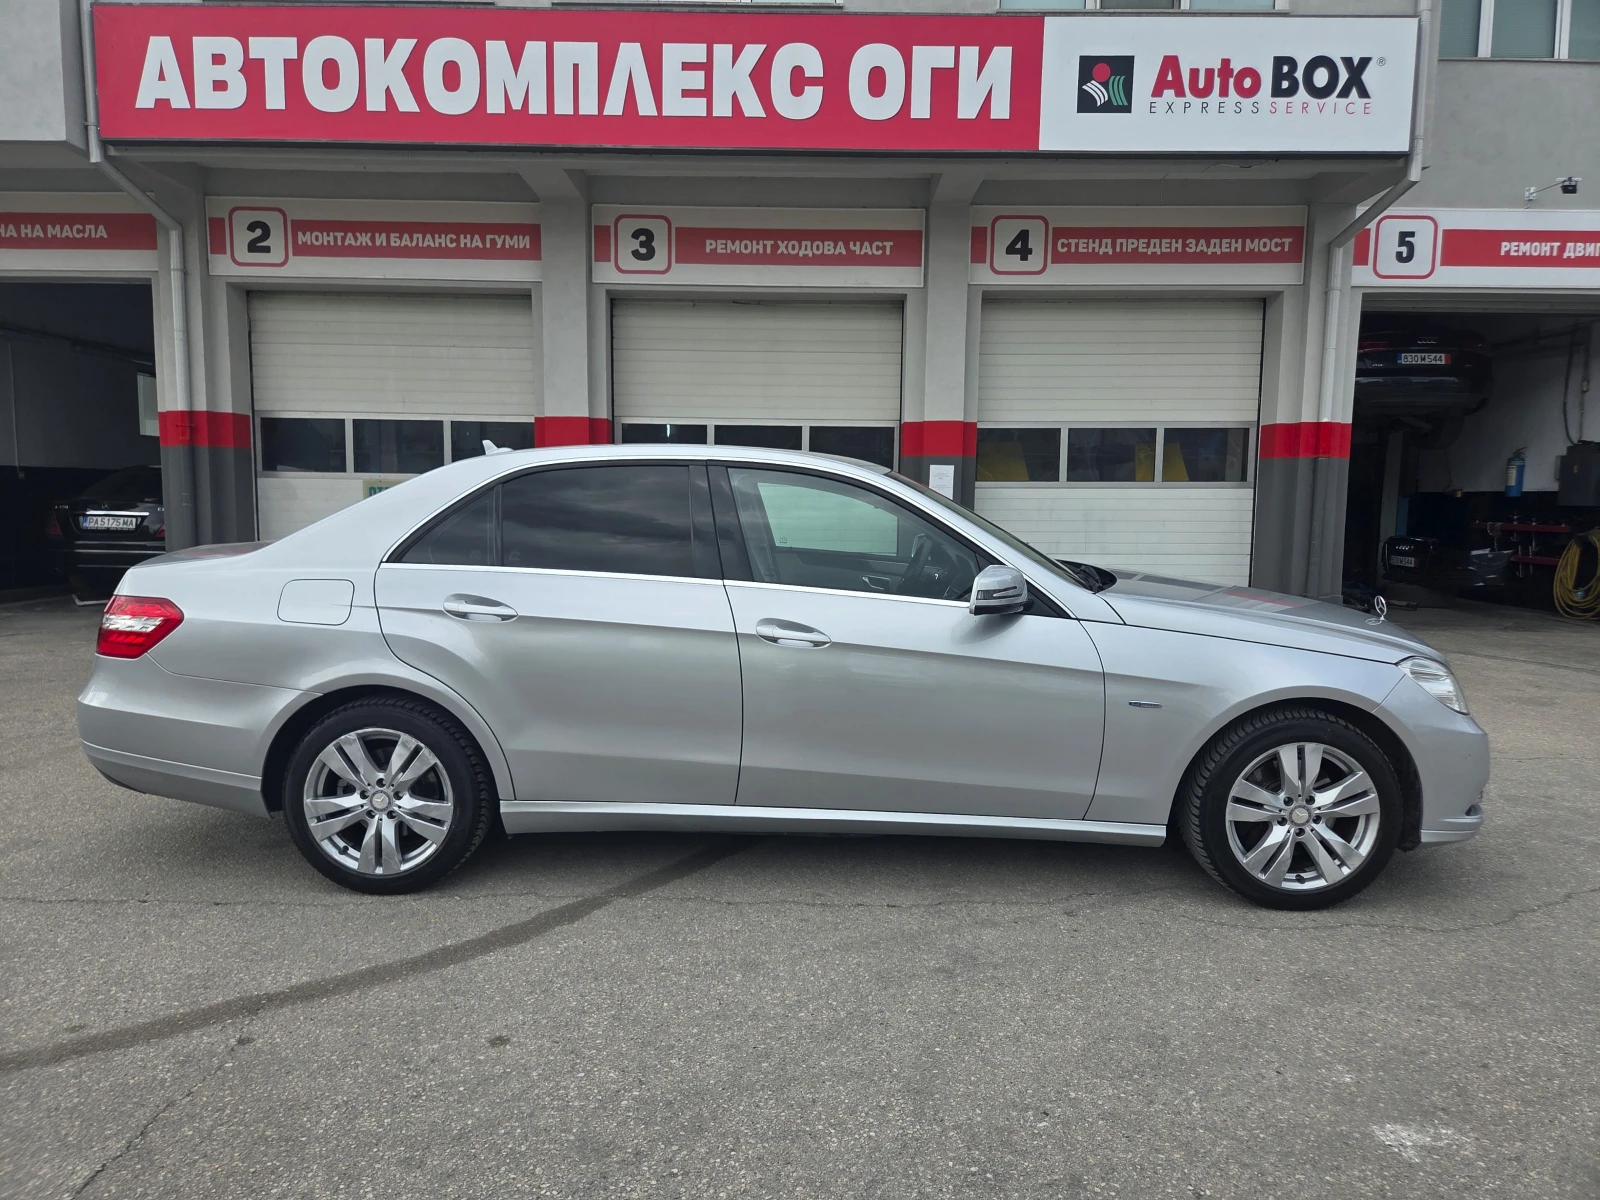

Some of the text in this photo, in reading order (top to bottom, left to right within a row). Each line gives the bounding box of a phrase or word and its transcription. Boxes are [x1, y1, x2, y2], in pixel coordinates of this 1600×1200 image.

[135, 36, 1013, 120] АВТОКОМПЛЕКС ОГИ
[1151, 55, 1372, 99] Auto BOX
[1149, 101, 1371, 115] EXPRESS SERVICE
[20, 224, 45, 238] НА
[47, 224, 108, 238] МАСЛА
[246, 220, 271, 253] 2
[297, 231, 531, 249] МОНТАЖ И БАЛАНС НА ГУМИ
[631, 228, 656, 261] 3
[705, 239, 893, 257] РЕМОНТ ХОДОВА ЧАСТ
[1005, 229, 1033, 261] 4
[1057, 237, 1292, 255] СТЕНД ПРЕДЕН ЗАДЕН МОСТ
[1395, 231, 1415, 263] 5
[1500, 241, 1561, 256] РЕМОНТ
